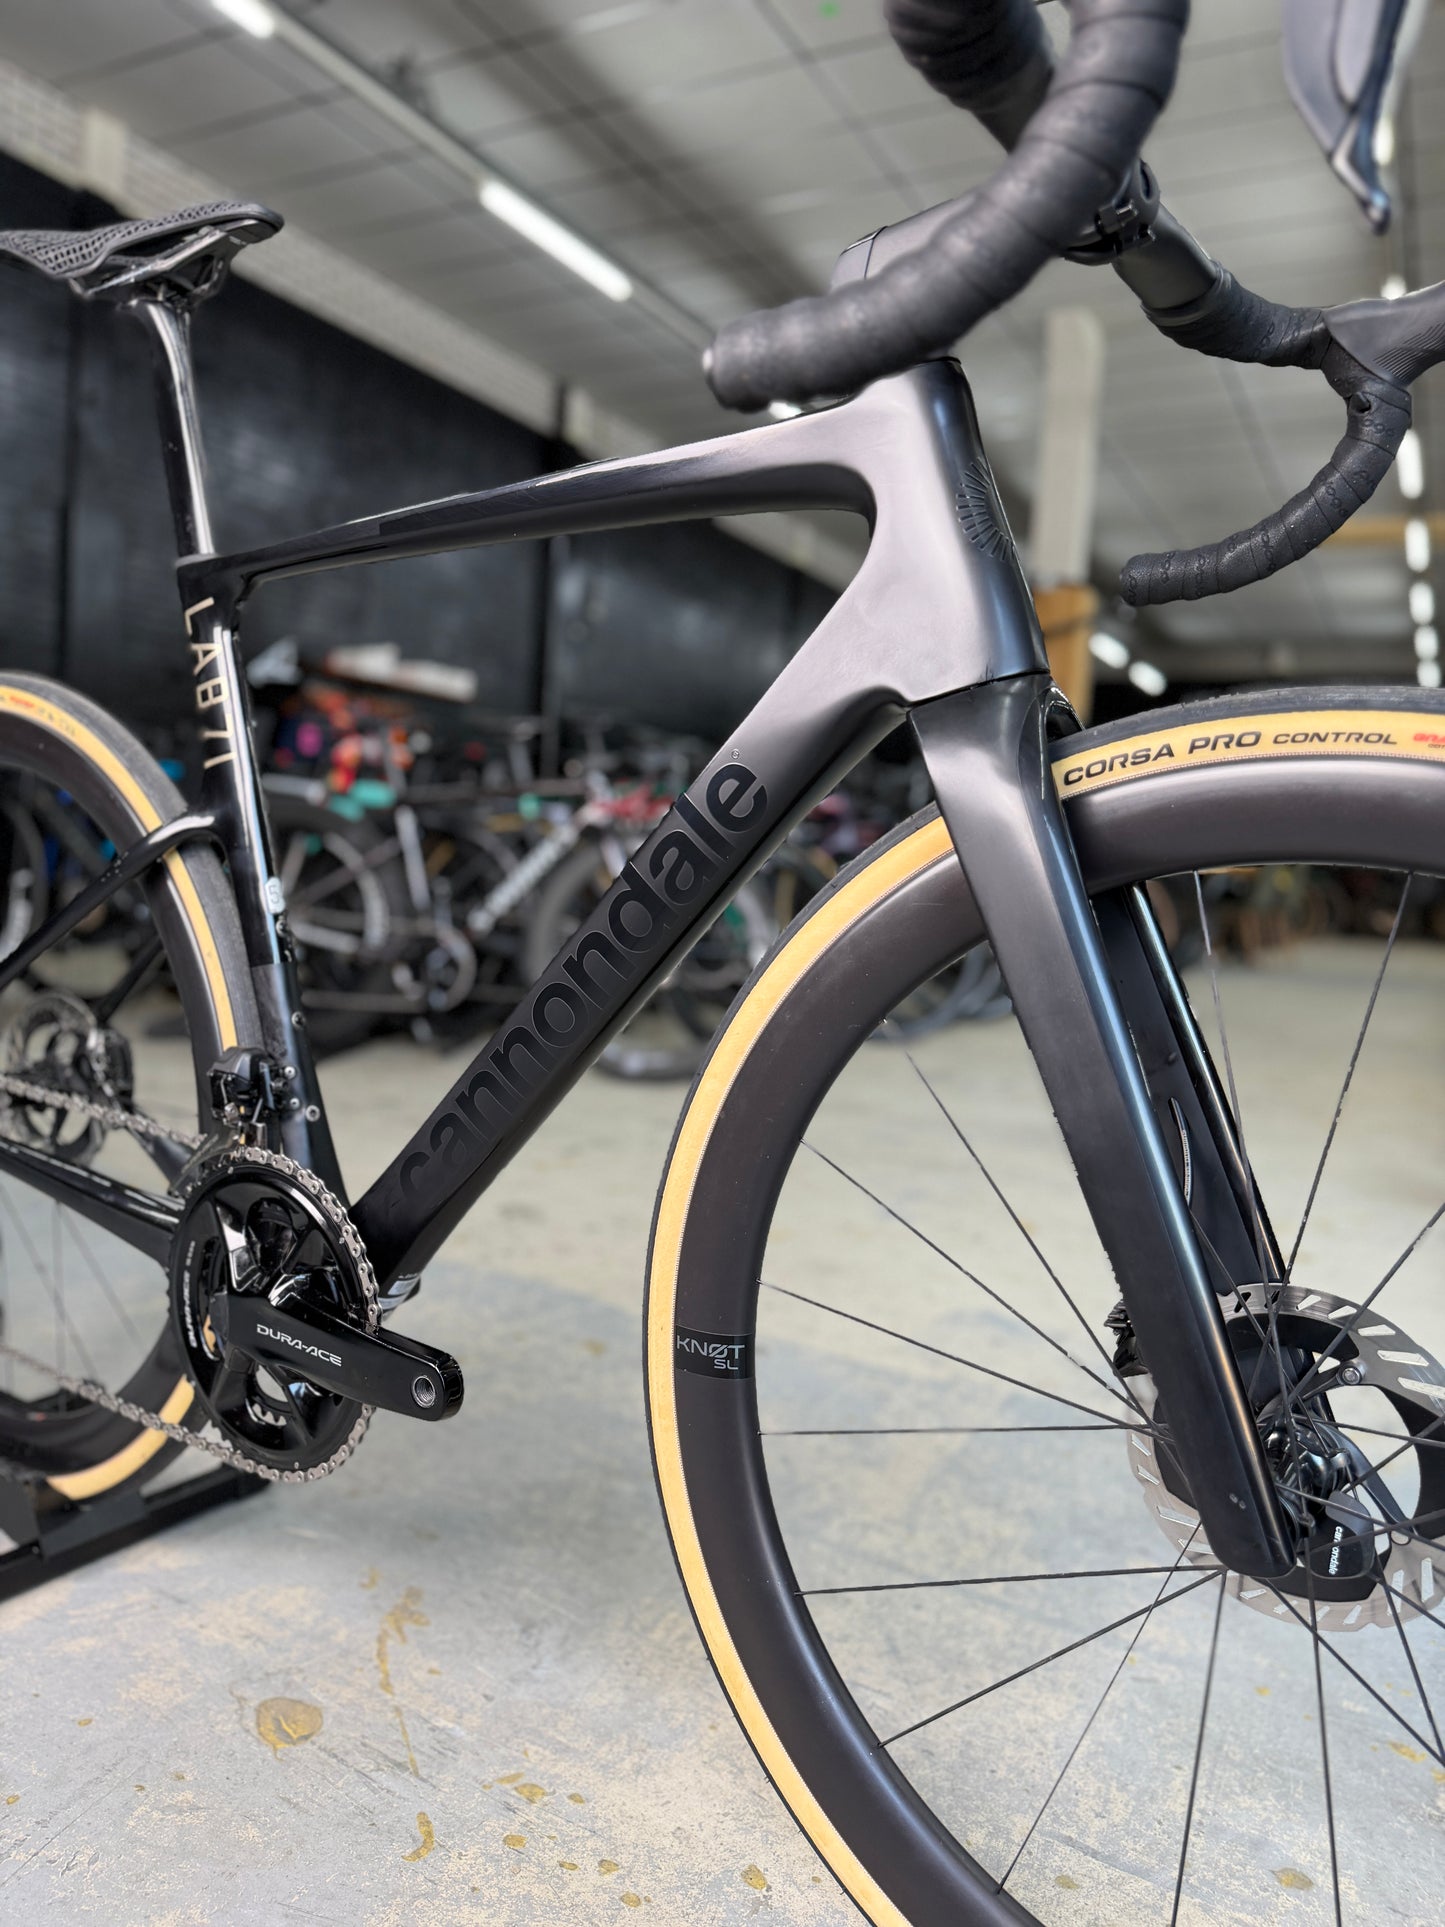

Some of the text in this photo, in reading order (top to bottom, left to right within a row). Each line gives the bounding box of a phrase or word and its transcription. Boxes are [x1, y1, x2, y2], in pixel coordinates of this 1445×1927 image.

[185, 597, 238, 770] LAB71
[1064, 743, 1175, 786] CORSA
[1188, 731, 1262, 755] PRO
[1273, 732, 1398, 746] CONTROL
[400, 762, 768, 1204] cannondale
[257, 1323, 343, 1368] DURA-ACE
[714, 1360, 739, 1370] SL
[1328, 1526, 1343, 1575] canondale
